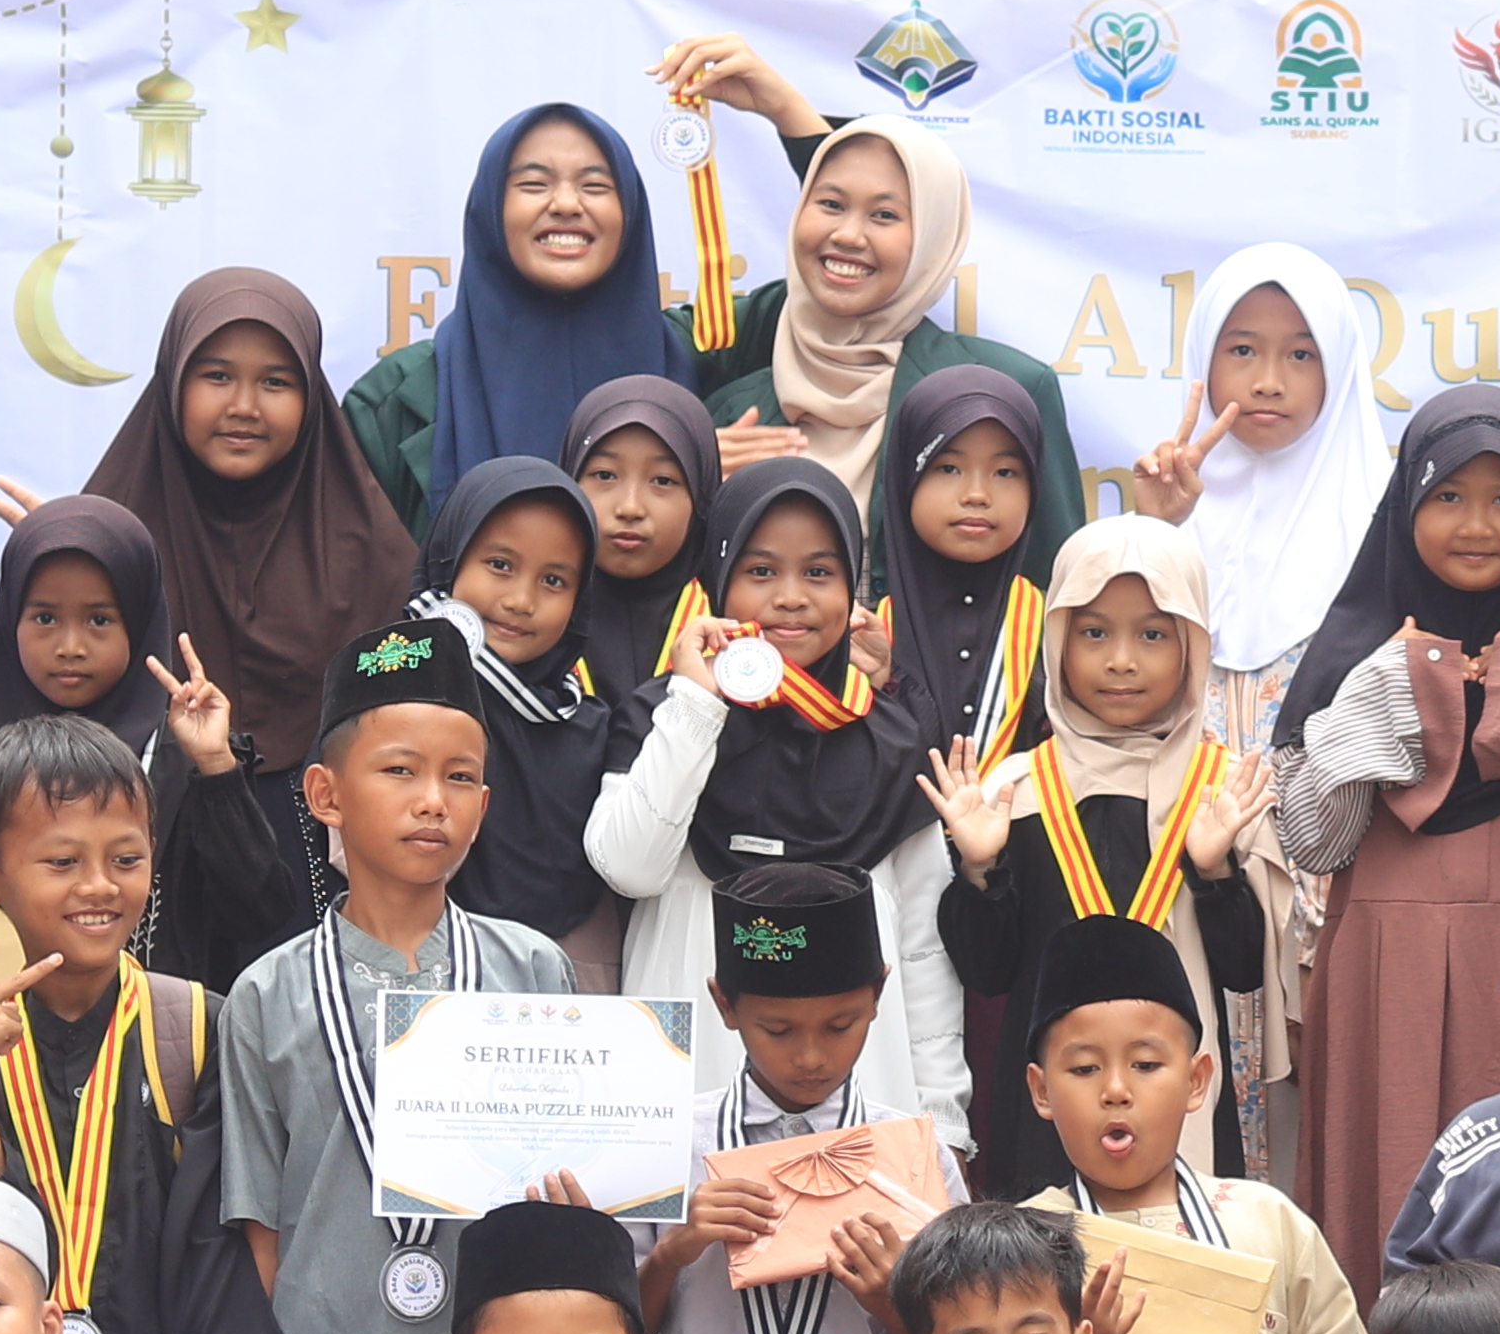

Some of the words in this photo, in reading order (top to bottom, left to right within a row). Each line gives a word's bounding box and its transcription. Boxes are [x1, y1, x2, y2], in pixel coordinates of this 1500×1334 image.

[1270, 91, 1370, 112] STIU
[1043, 108, 1114, 128] BAKTI
[1122, 109, 1205, 129] SOSIAL
[1260, 116, 1302, 127] SAINS
[1305, 116, 1322, 127] AL
[1327, 116, 1379, 129] QUR'AN
[1072, 130, 1176, 147] INDONESIA
[1290, 130, 1349, 140] SUBANG
[463, 1046, 611, 1066] SERTIFIKAT
[394, 1099, 446, 1113] JUARA
[450, 1100, 461, 1114] II
[465, 1101, 520, 1115] LOMBA
[525, 1102, 586, 1117] PUZZLE
[590, 1104, 675, 1120] HIJAIYYAH
